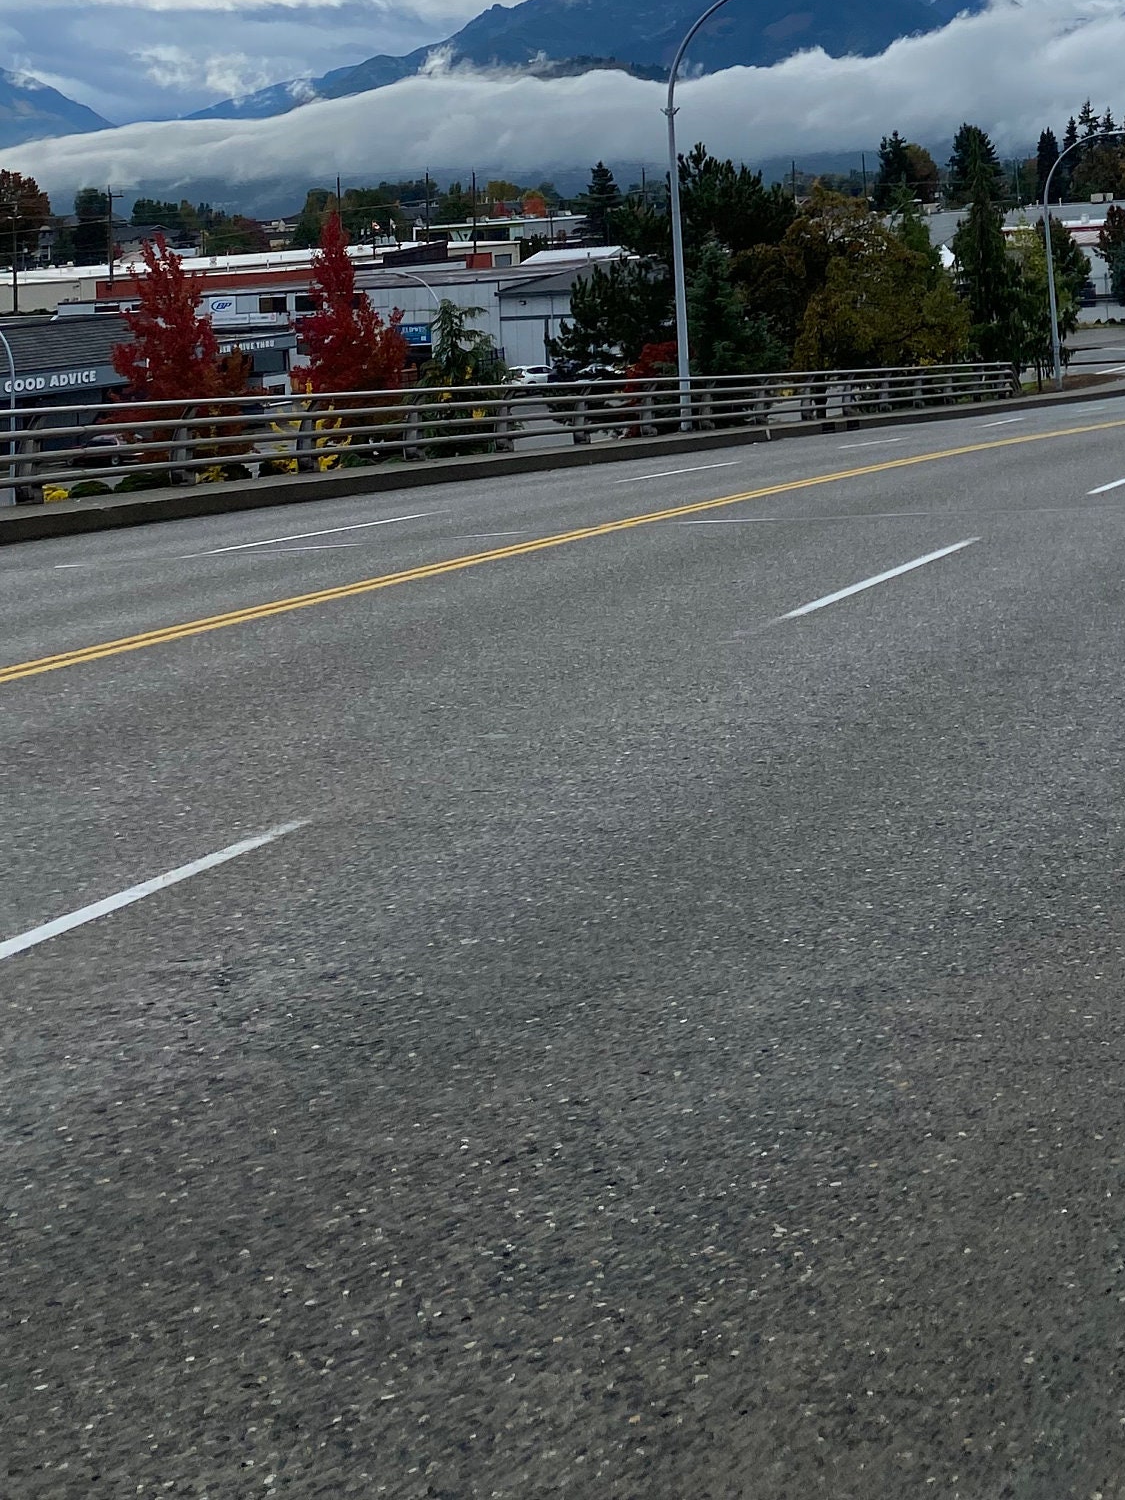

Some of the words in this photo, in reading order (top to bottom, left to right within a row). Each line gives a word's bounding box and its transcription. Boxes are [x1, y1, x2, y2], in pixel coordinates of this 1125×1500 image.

[256, 340, 274, 349] THRU
[4, 378, 45, 393] GOOD
[49, 370, 97, 387] ADVICE
